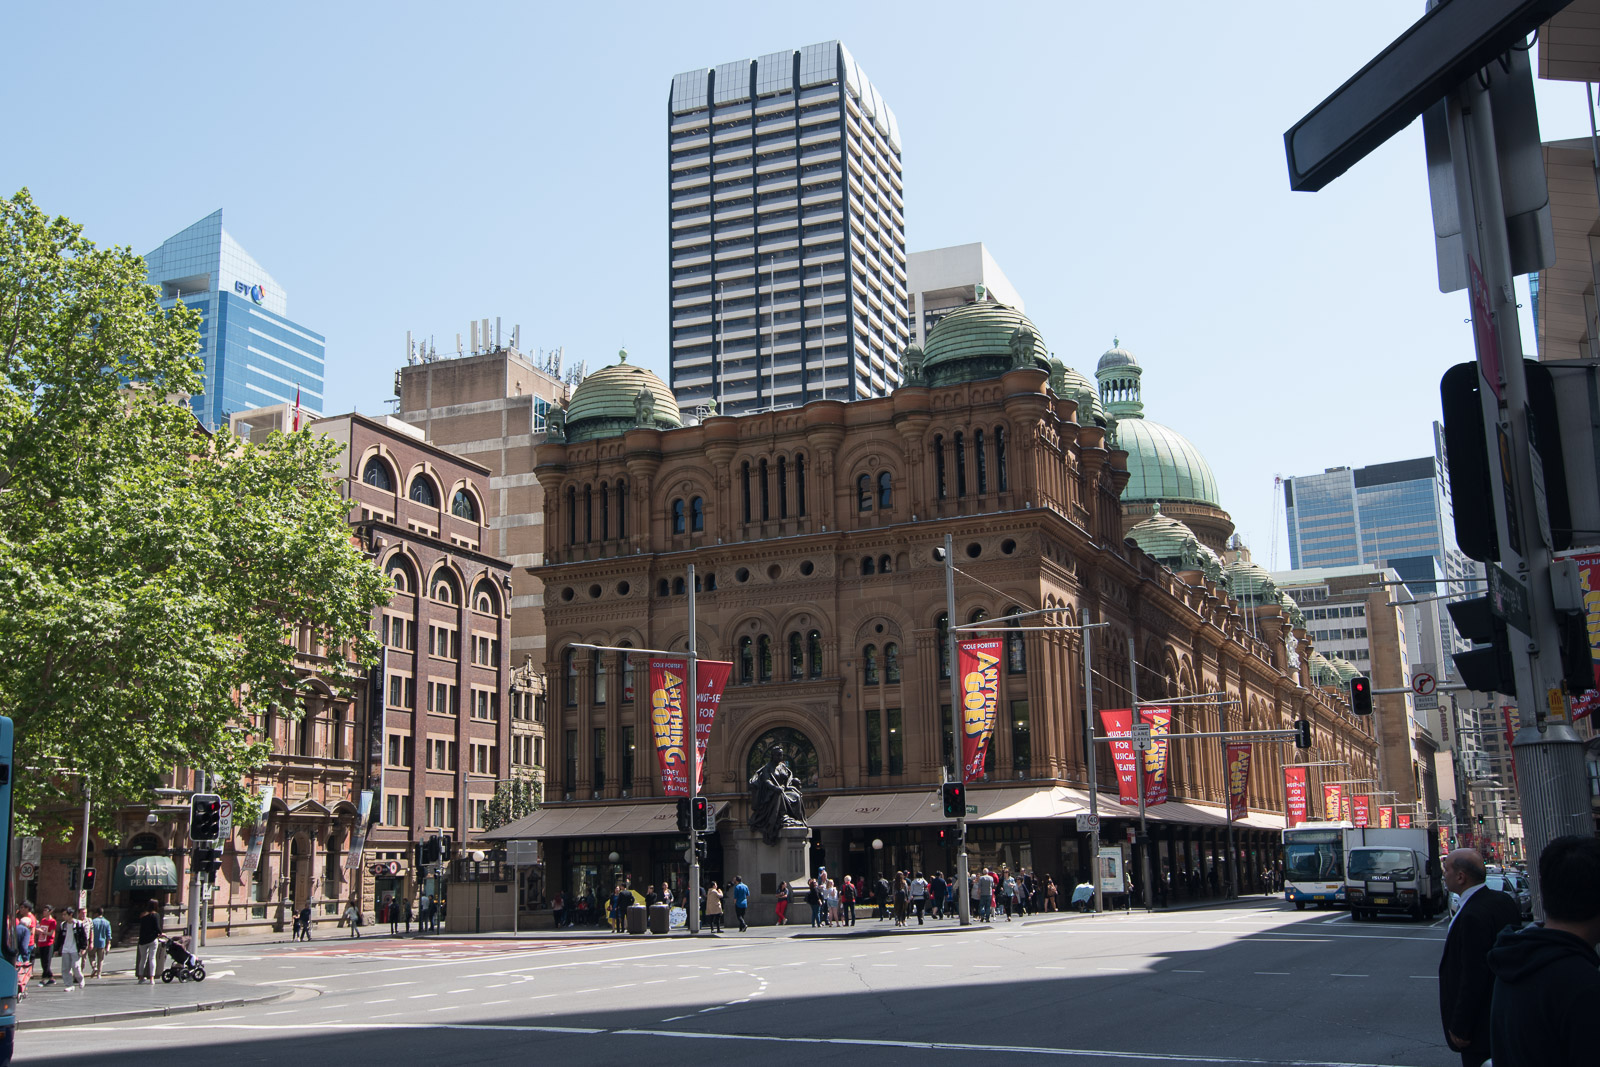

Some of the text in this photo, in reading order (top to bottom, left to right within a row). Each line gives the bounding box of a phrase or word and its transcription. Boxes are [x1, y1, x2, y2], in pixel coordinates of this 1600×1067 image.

[235, 280, 251, 296] BT
[708, 679, 713, 687] A
[965, 672, 985, 738] GOES
[977, 651, 1000, 750] ANYTHING
[664, 670, 686, 766] ANYTHING
[700, 708, 714, 718] FOR
[652, 689, 671, 751] GOES
[1115, 720, 1121, 728] A
[1115, 752, 1135, 760] USICAL
[1117, 763, 1136, 772] EATRE
[22, 866, 31, 874] 30
[124, 864, 169, 877] OPALS
[130, 878, 163, 887] PEARLS
